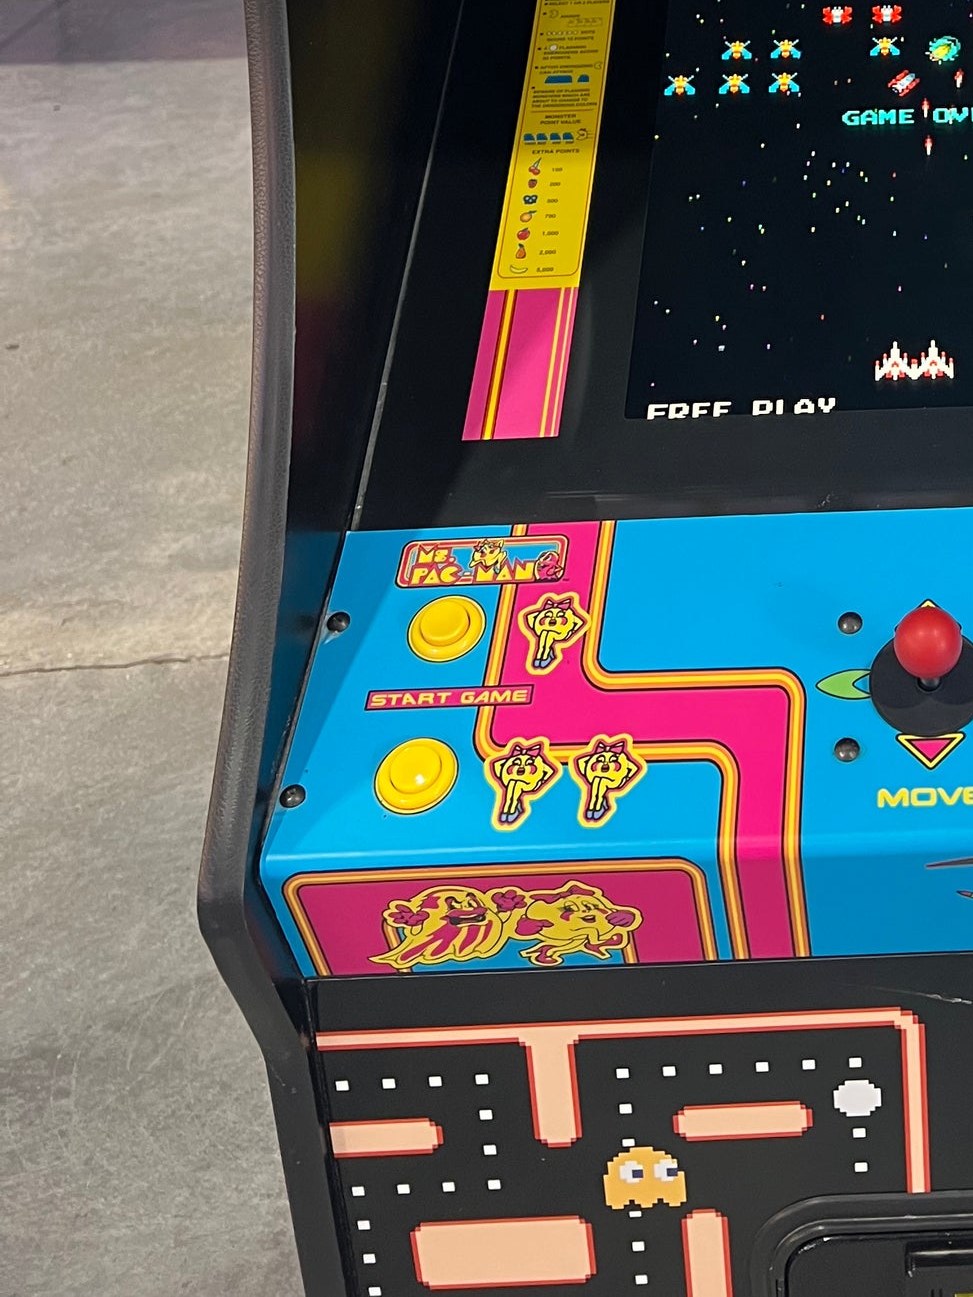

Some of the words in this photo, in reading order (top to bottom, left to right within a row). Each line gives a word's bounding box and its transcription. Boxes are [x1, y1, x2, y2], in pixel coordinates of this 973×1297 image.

[841, 109, 915, 126] GAME
[646, 400, 732, 420] FREE
[369, 691, 452, 708] START
[460, 689, 529, 704] GAME
